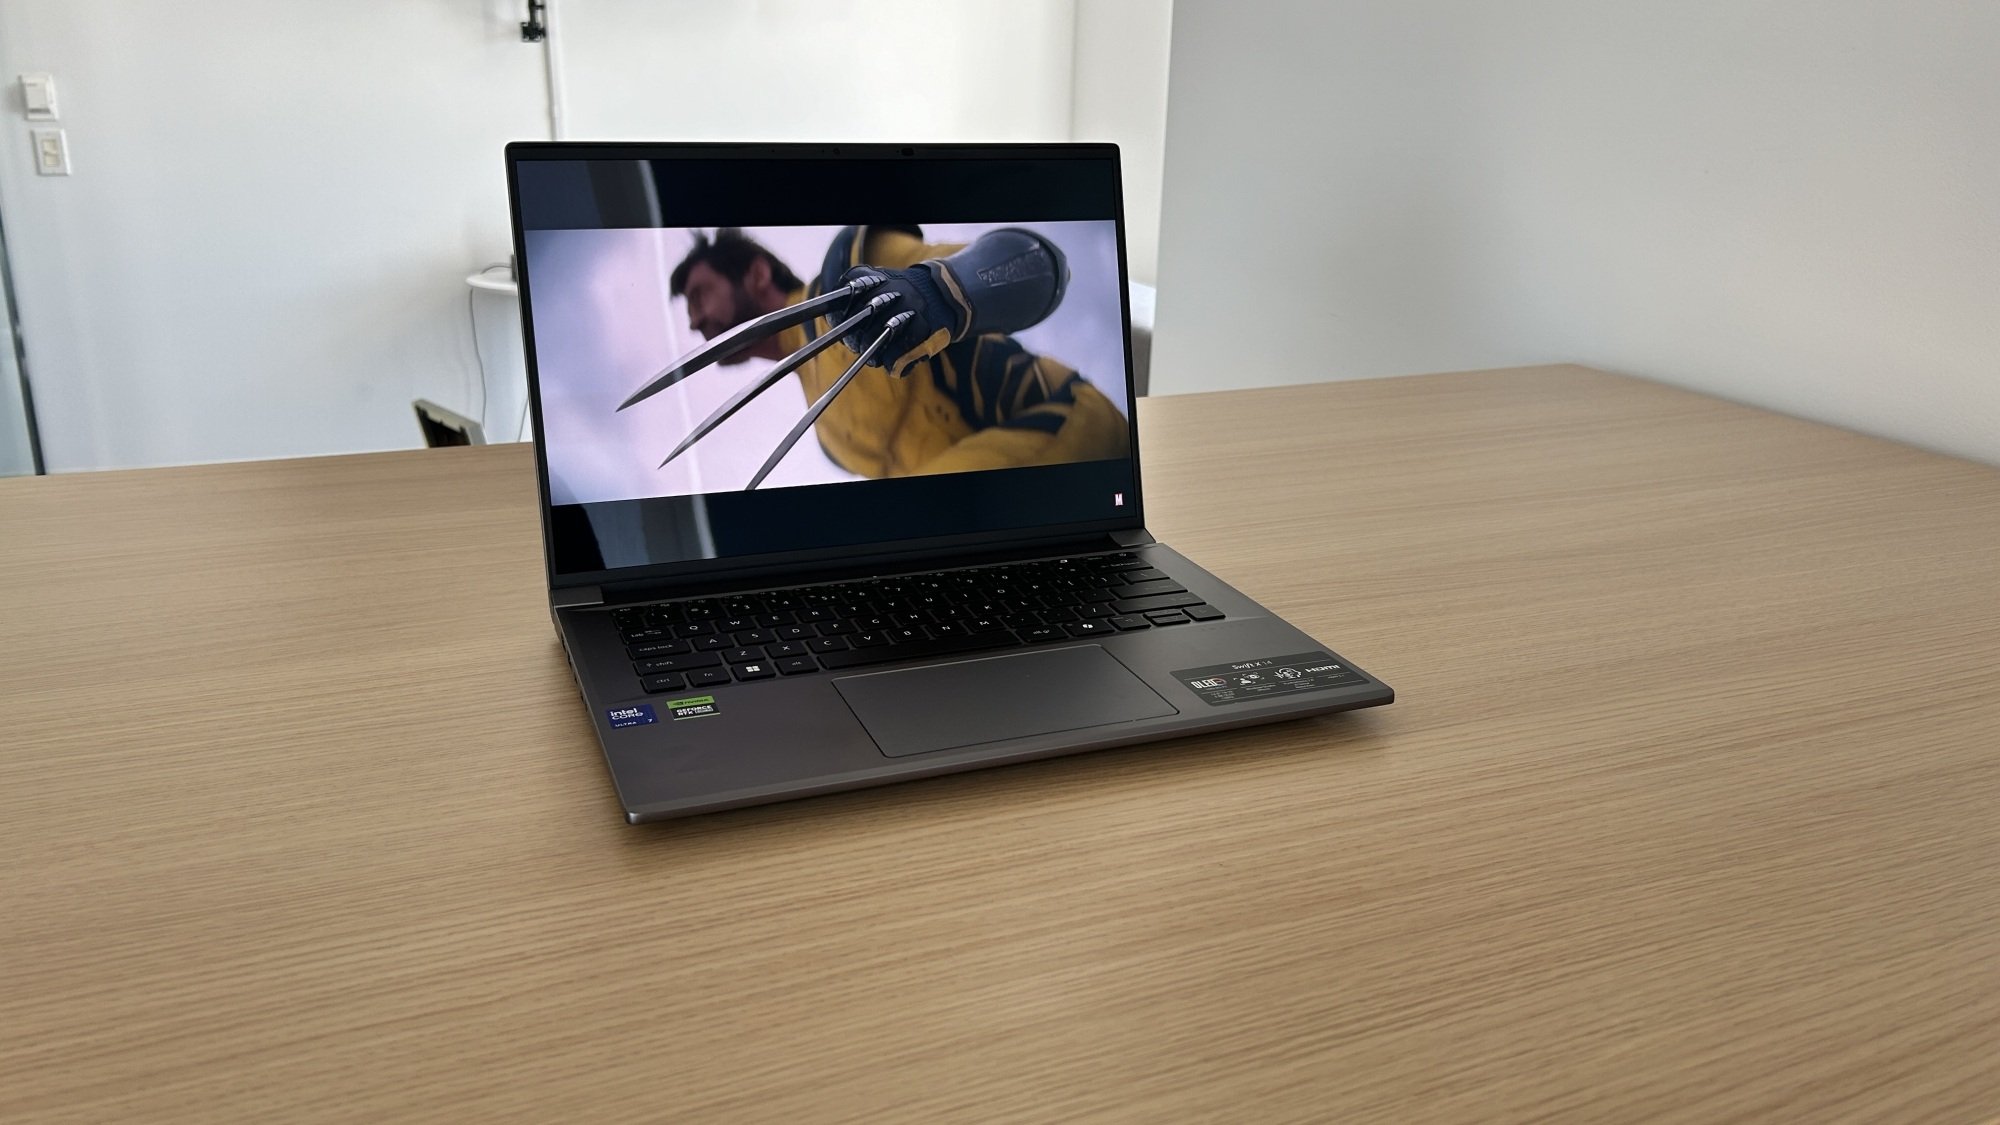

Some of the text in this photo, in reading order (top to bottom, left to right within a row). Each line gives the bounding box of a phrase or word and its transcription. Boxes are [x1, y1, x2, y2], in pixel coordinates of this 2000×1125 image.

[1231, 662, 1256, 670] Swift
[1304, 663, 1341, 673] HDMI
[610, 707, 638, 717] intel
[611, 711, 644, 721] CORE
